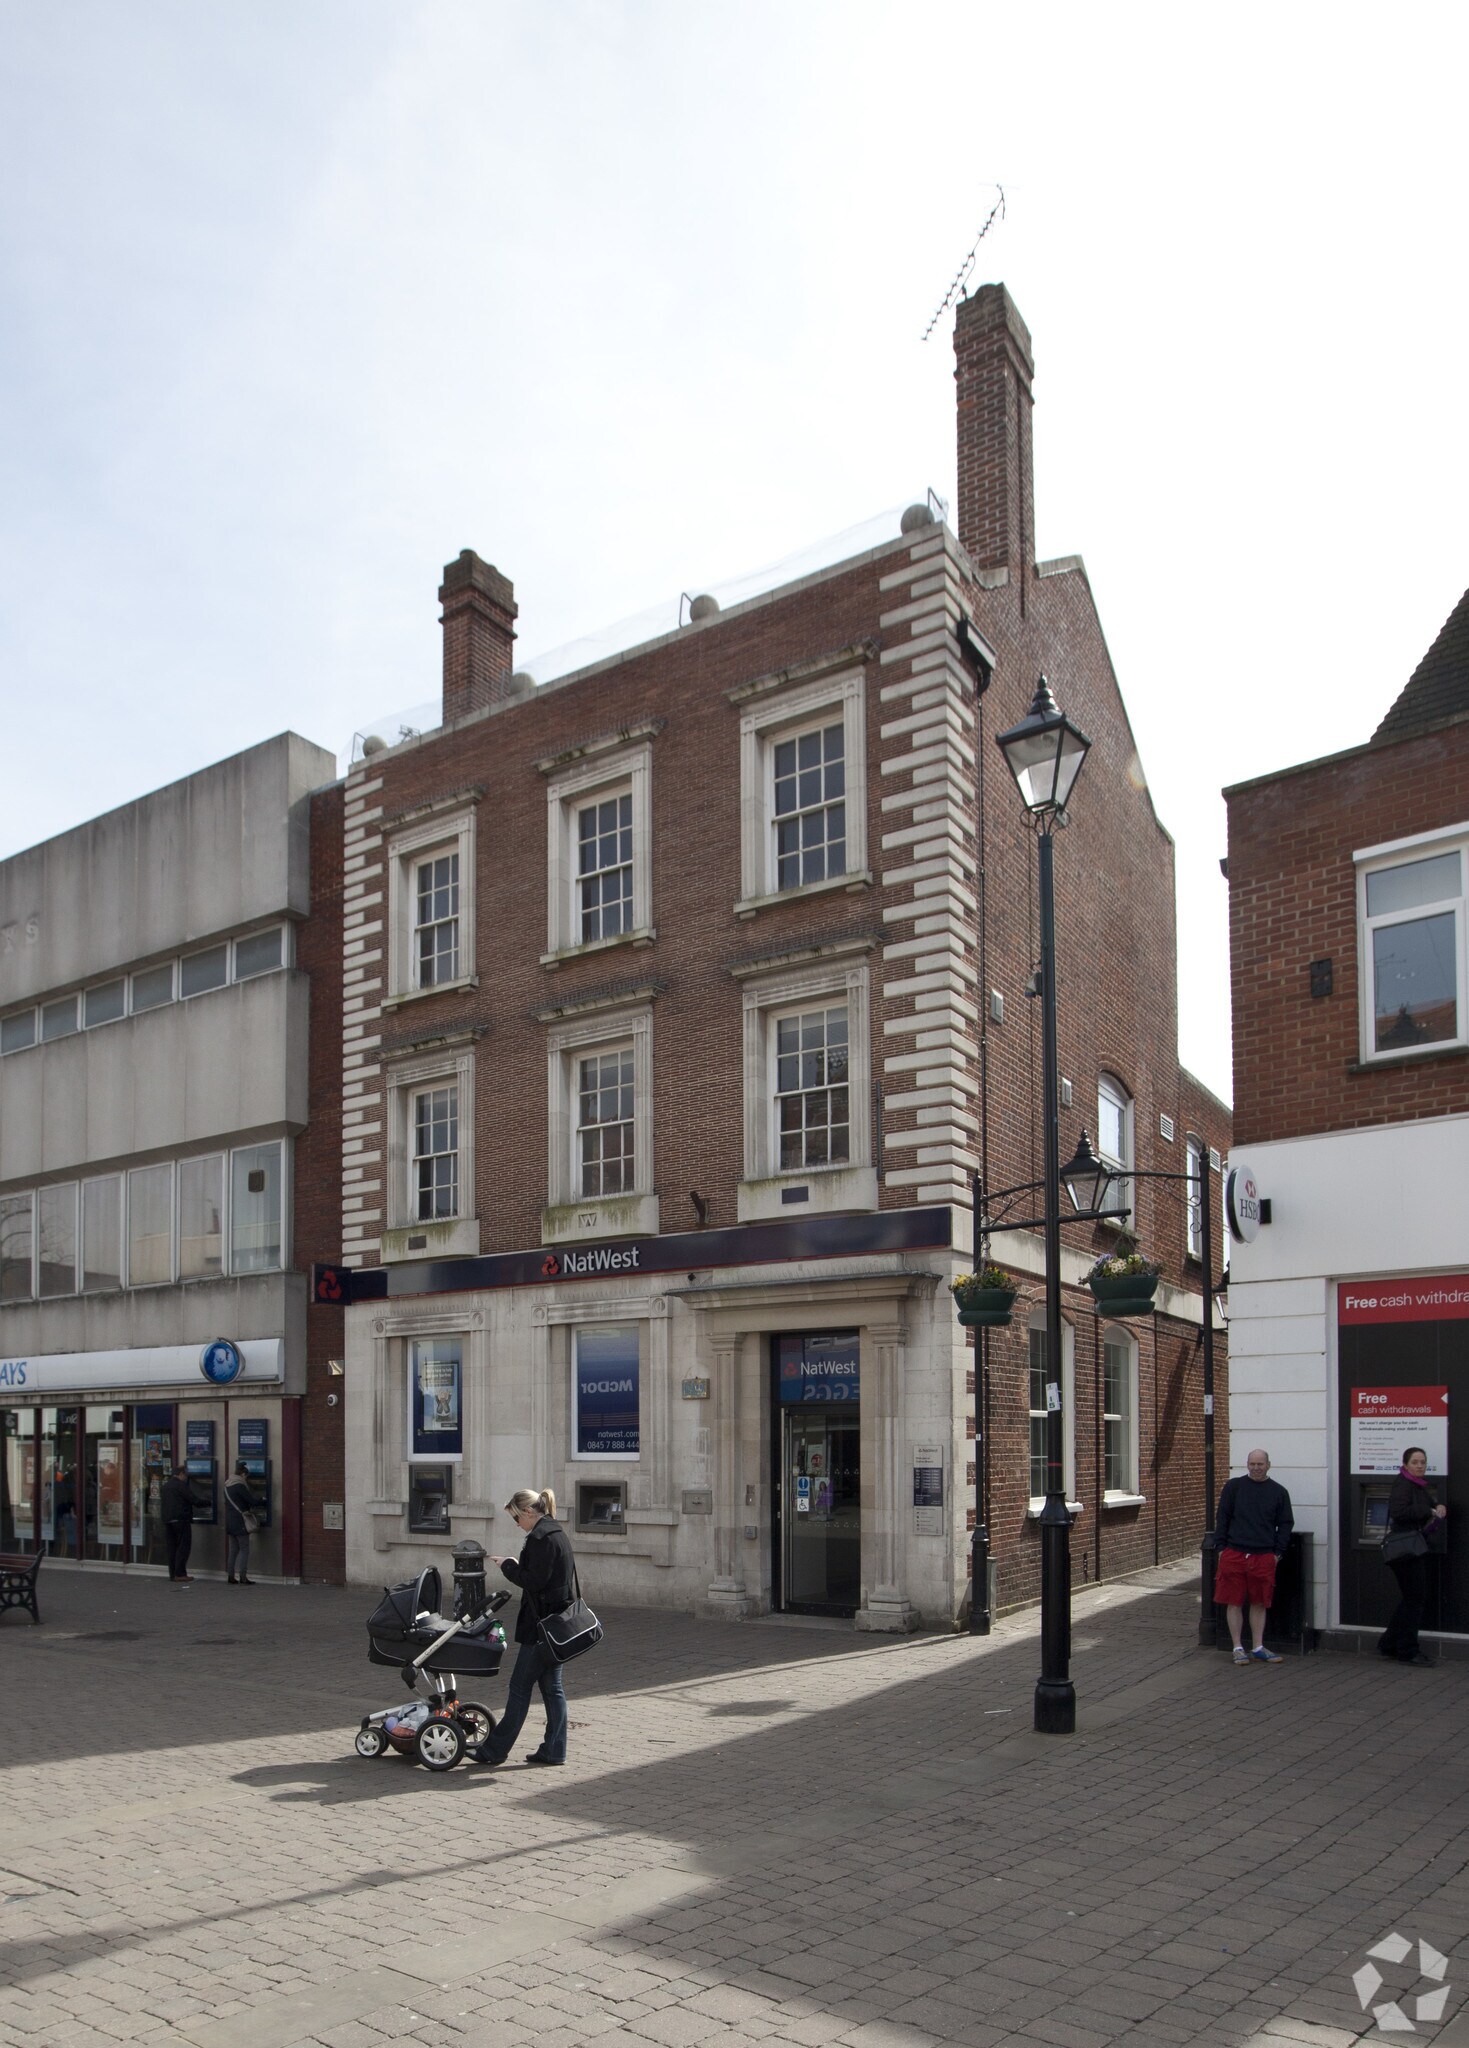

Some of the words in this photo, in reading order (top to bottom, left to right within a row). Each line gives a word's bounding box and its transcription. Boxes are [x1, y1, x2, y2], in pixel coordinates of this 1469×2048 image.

[563, 1246, 640, 1273] NatWest
[1345, 1296, 1377, 1309] Free
[1380, 1293, 1412, 1307] cash
[800, 1360, 856, 1375] NatWest
[1358, 1392, 1388, 1404] Free
[1358, 1406, 1377, 1414] cash
[1379, 1405, 1432, 1414] withdrawals
[597, 1430, 639, 1438] natwest.com
[587, 1441, 604, 1449] 0845
[606, 1441, 610, 1449] 7
[611, 1441, 625, 1449] 888
